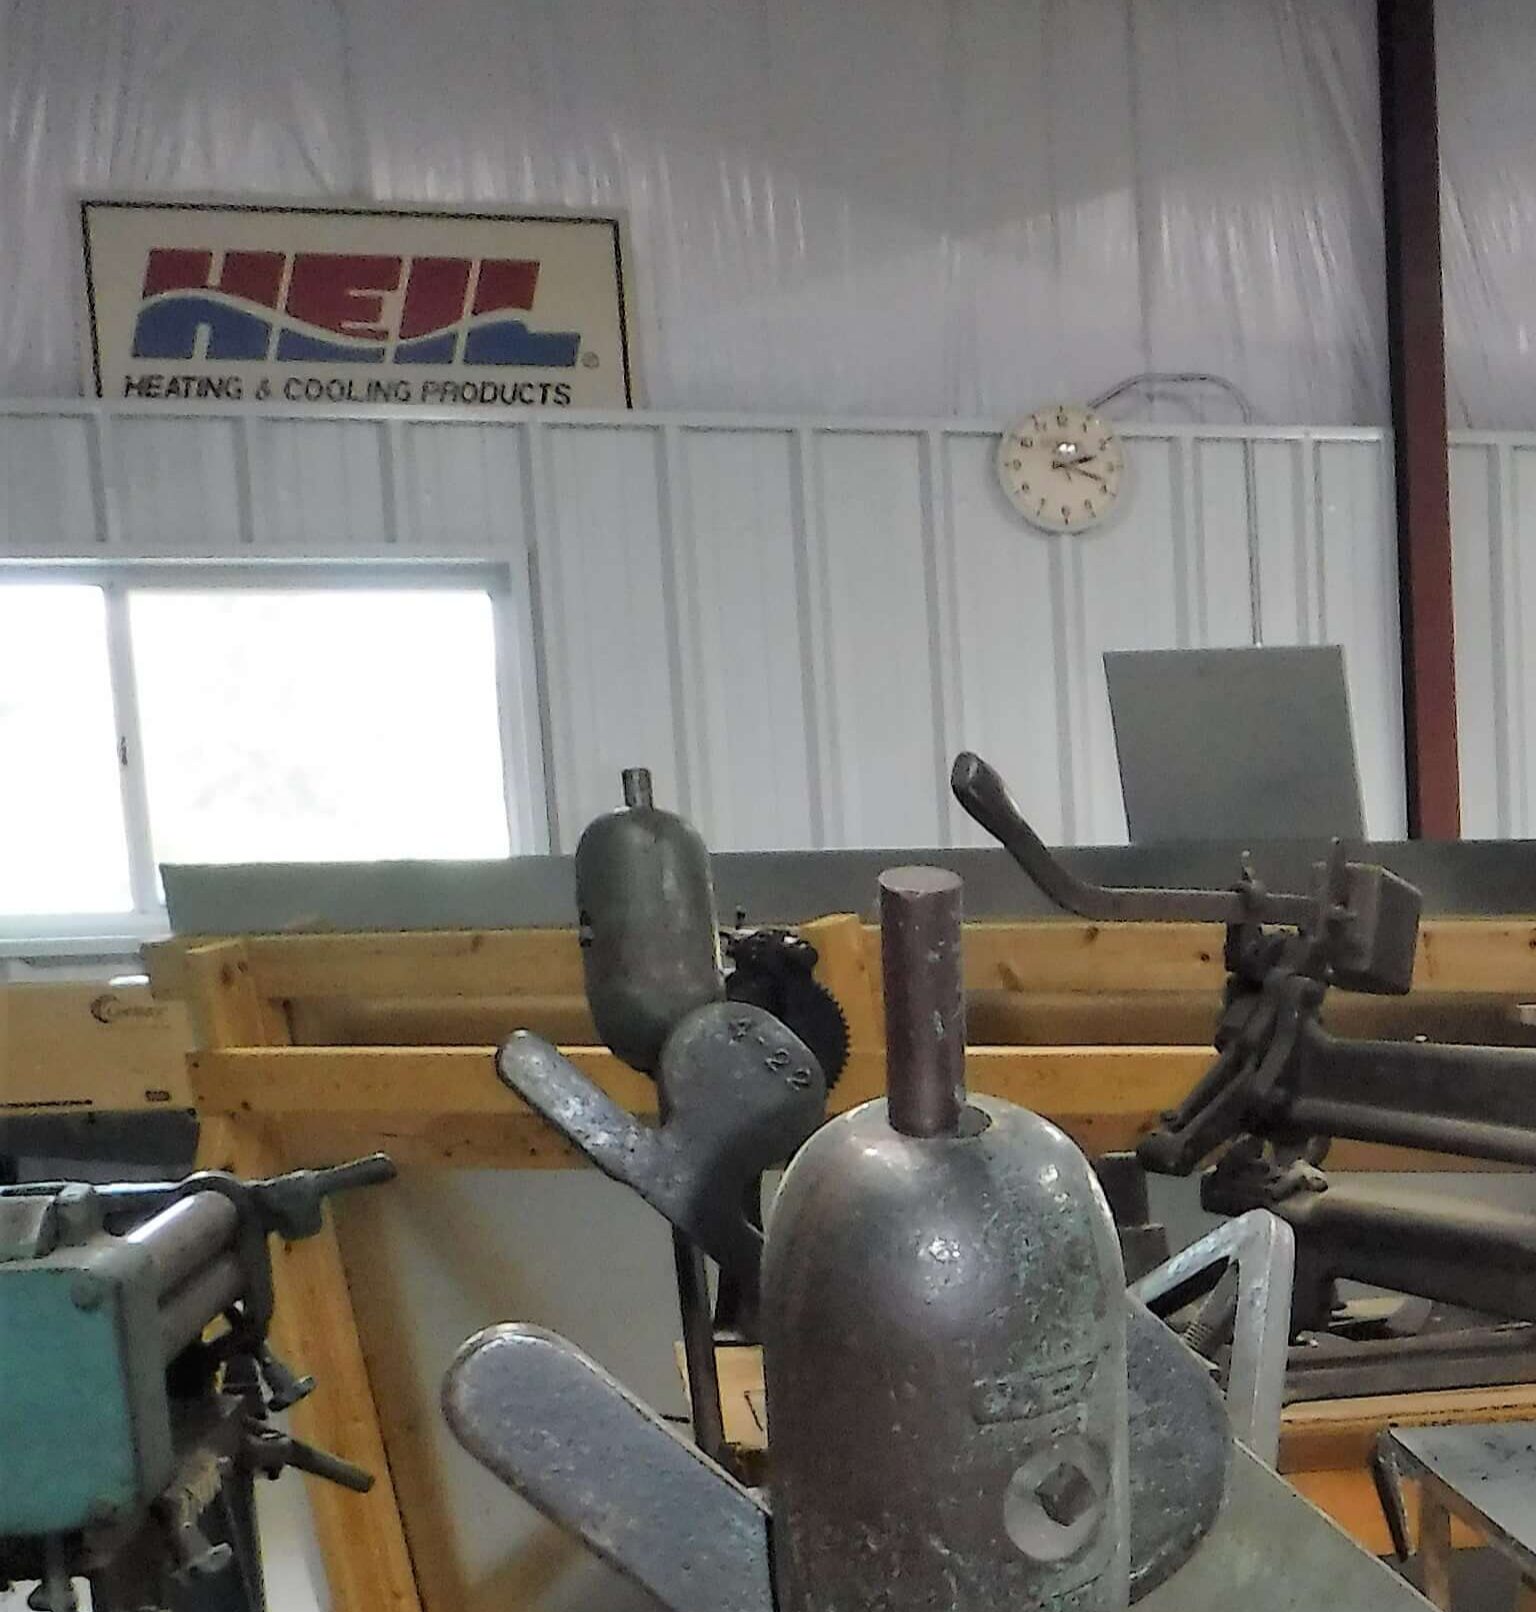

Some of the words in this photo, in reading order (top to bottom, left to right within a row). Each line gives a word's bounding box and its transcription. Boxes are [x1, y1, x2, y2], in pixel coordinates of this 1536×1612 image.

[132, 248, 581, 367] HEIL
[124, 374, 242, 402] HEATING
[255, 376, 272, 401] &
[284, 376, 412, 404] COOLING
[420, 378, 572, 407] PRODUCTS
